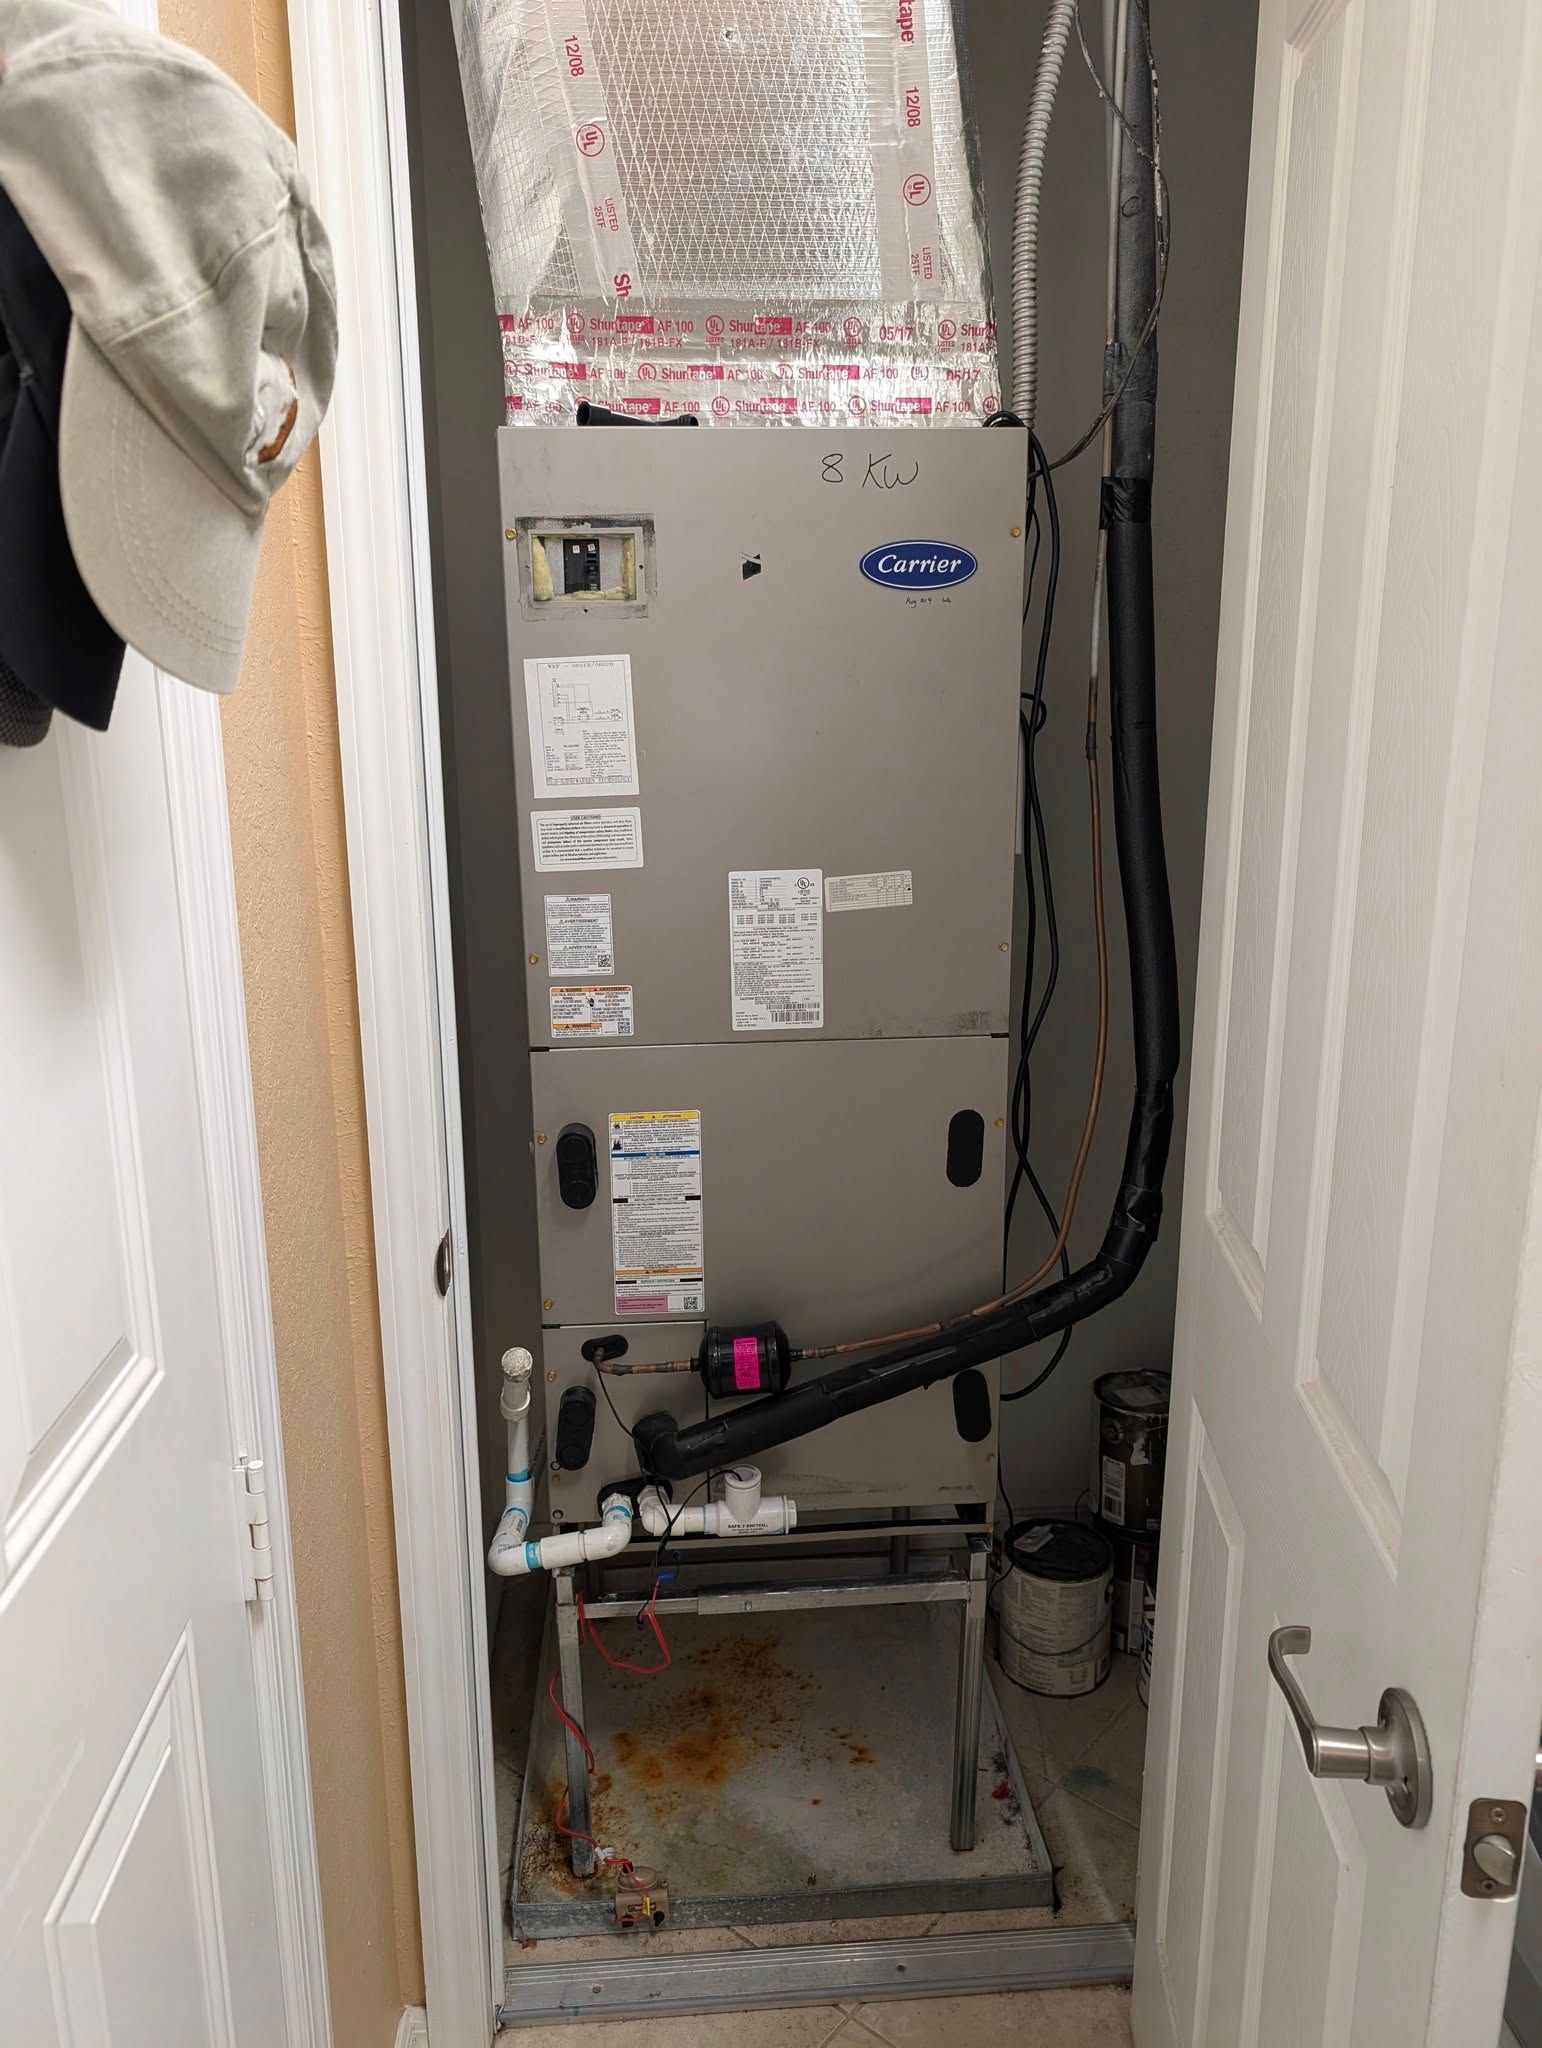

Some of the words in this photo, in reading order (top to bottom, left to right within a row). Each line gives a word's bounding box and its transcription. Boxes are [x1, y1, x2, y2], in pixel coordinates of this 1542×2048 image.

[563, 34, 585, 77] 12/08
[905, 86, 921, 128] 12/08
[604, 197, 619, 233] LISTED
[922, 246, 933, 280] LISTED
[657, 320, 672, 332] AF
[675, 320, 694, 332] 100
[729, 319, 780, 333] Shurtape
[879, 326, 913, 341] 05/17
[664, 401, 678, 412] AF
[682, 401, 700, 412] 100
[871, 400, 921, 413] Shurtape
[935, 401, 949, 412] AF
[952, 401, 971, 412] 100
[822, 453, 844, 483] 8
[877, 554, 962, 574] Carrier
